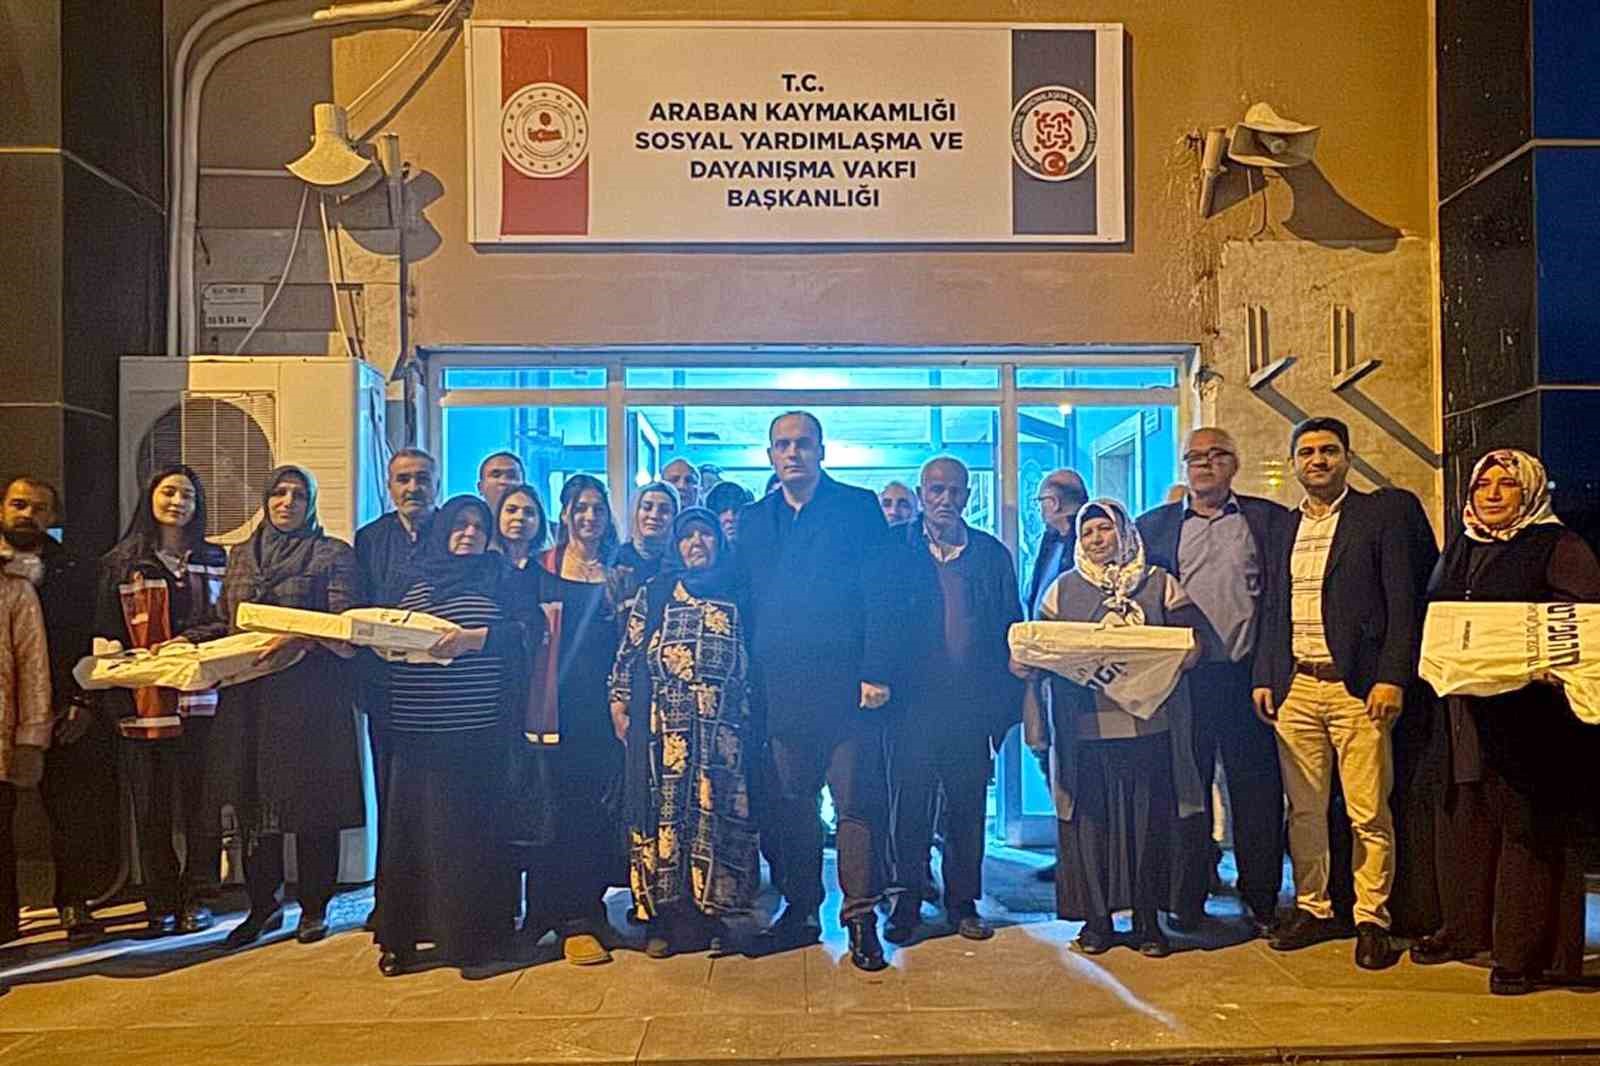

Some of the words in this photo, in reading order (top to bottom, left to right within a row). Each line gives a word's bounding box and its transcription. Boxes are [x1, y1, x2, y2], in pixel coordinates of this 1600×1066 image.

[781, 74, 825, 92] T.C.
[649, 103, 757, 121] ARABAN
[766, 99, 956, 121] KAYMAKAMLIĞI
[635, 132, 733, 150] SOSYAL
[740, 132, 923, 153] YARDIMLAŞMA
[929, 132, 963, 150] VE
[690, 161, 835, 182] DAYANIŞMA
[842, 161, 916, 179] VAKFI
[727, 186, 879, 211] BAŞKANLIĞI
